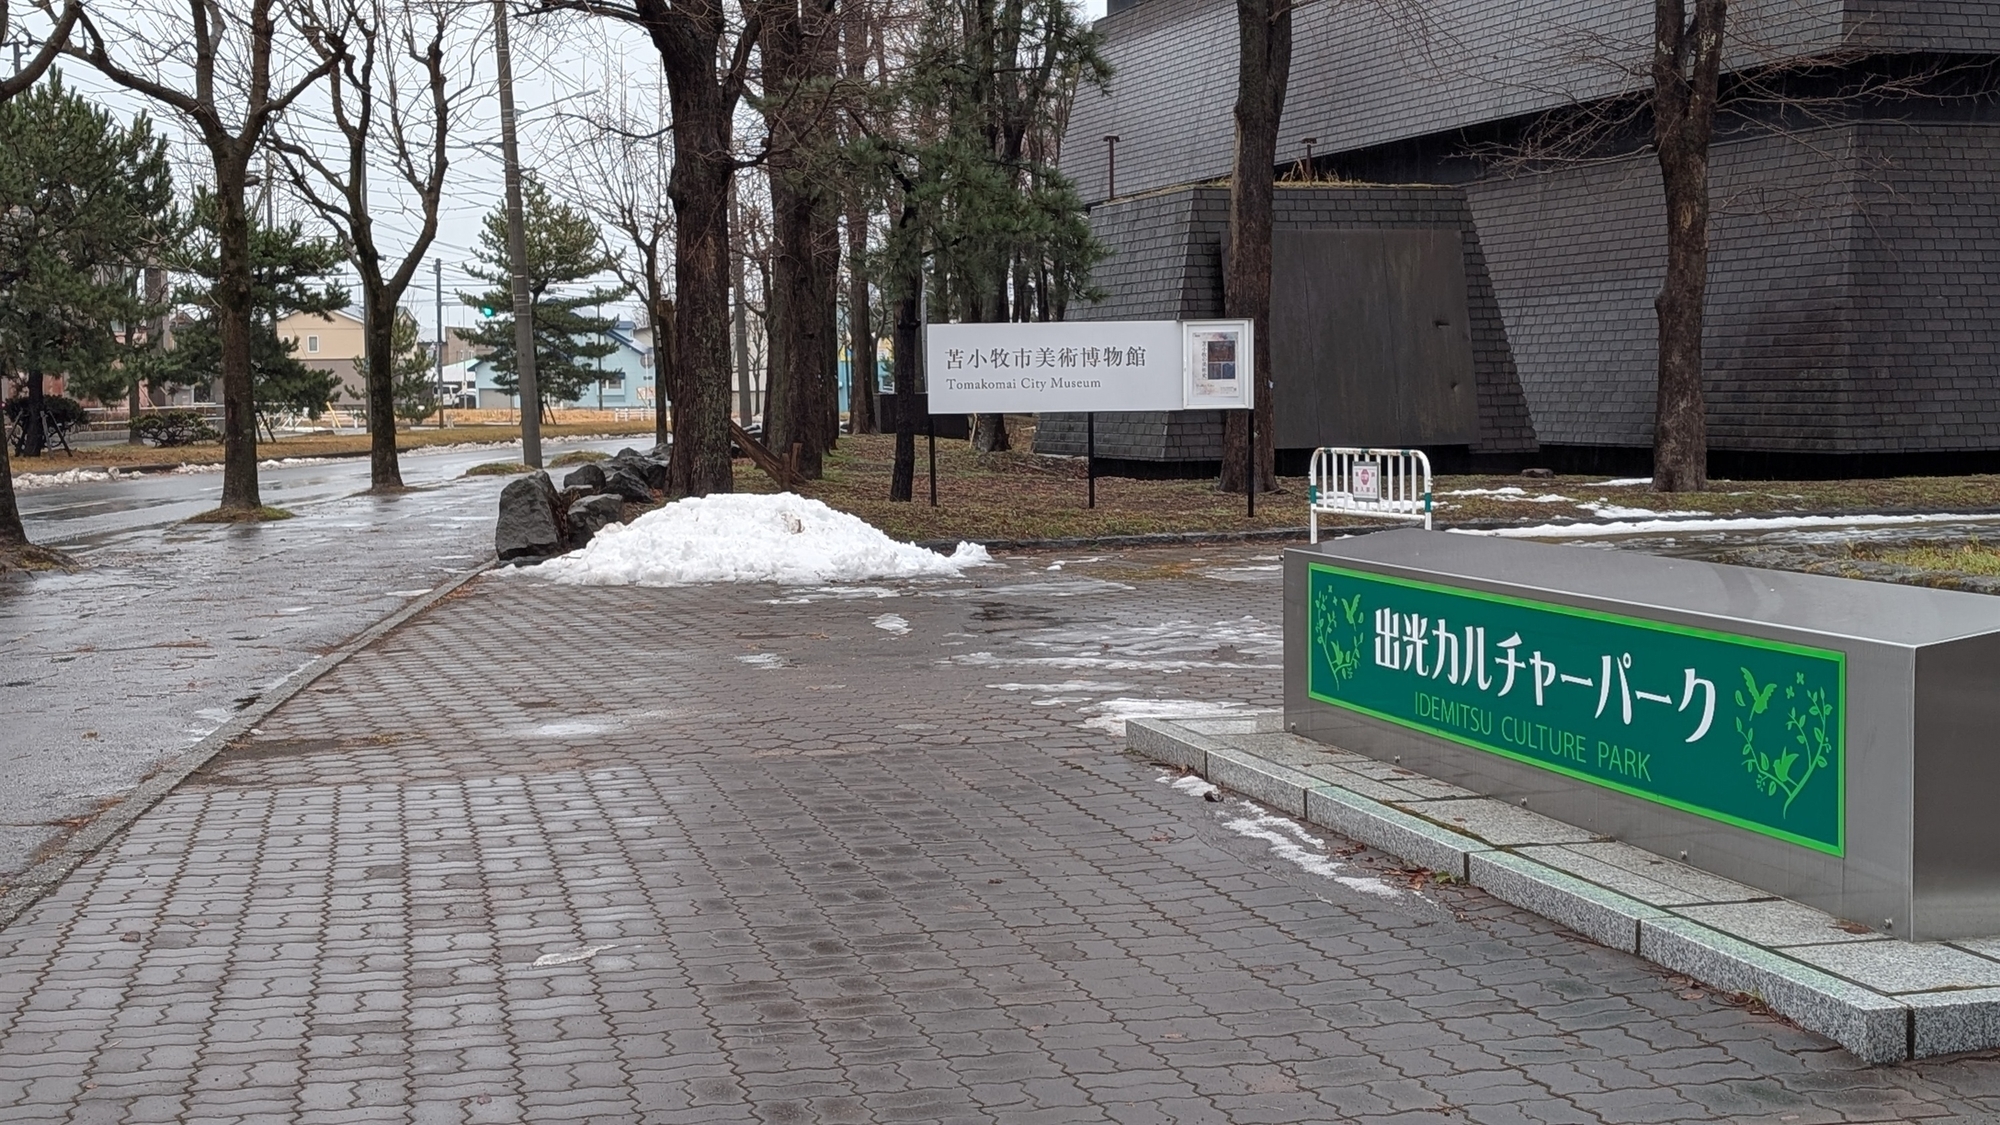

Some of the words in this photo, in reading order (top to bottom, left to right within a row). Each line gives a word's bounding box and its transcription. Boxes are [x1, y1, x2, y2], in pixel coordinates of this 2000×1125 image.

[945, 346, 1146, 370] 苫小牧市美術博物館
[946, 378, 1017, 390] Tomakomai
[1020, 377, 1047, 392] City
[1050, 377, 1101, 389] Museum
[1375, 607, 1716, 743] 出光カルチャーパーク
[1415, 691, 1492, 735] IDEMITSU
[1501, 716, 1587, 763] CULTURE
[1598, 741, 1652, 782] PARK
